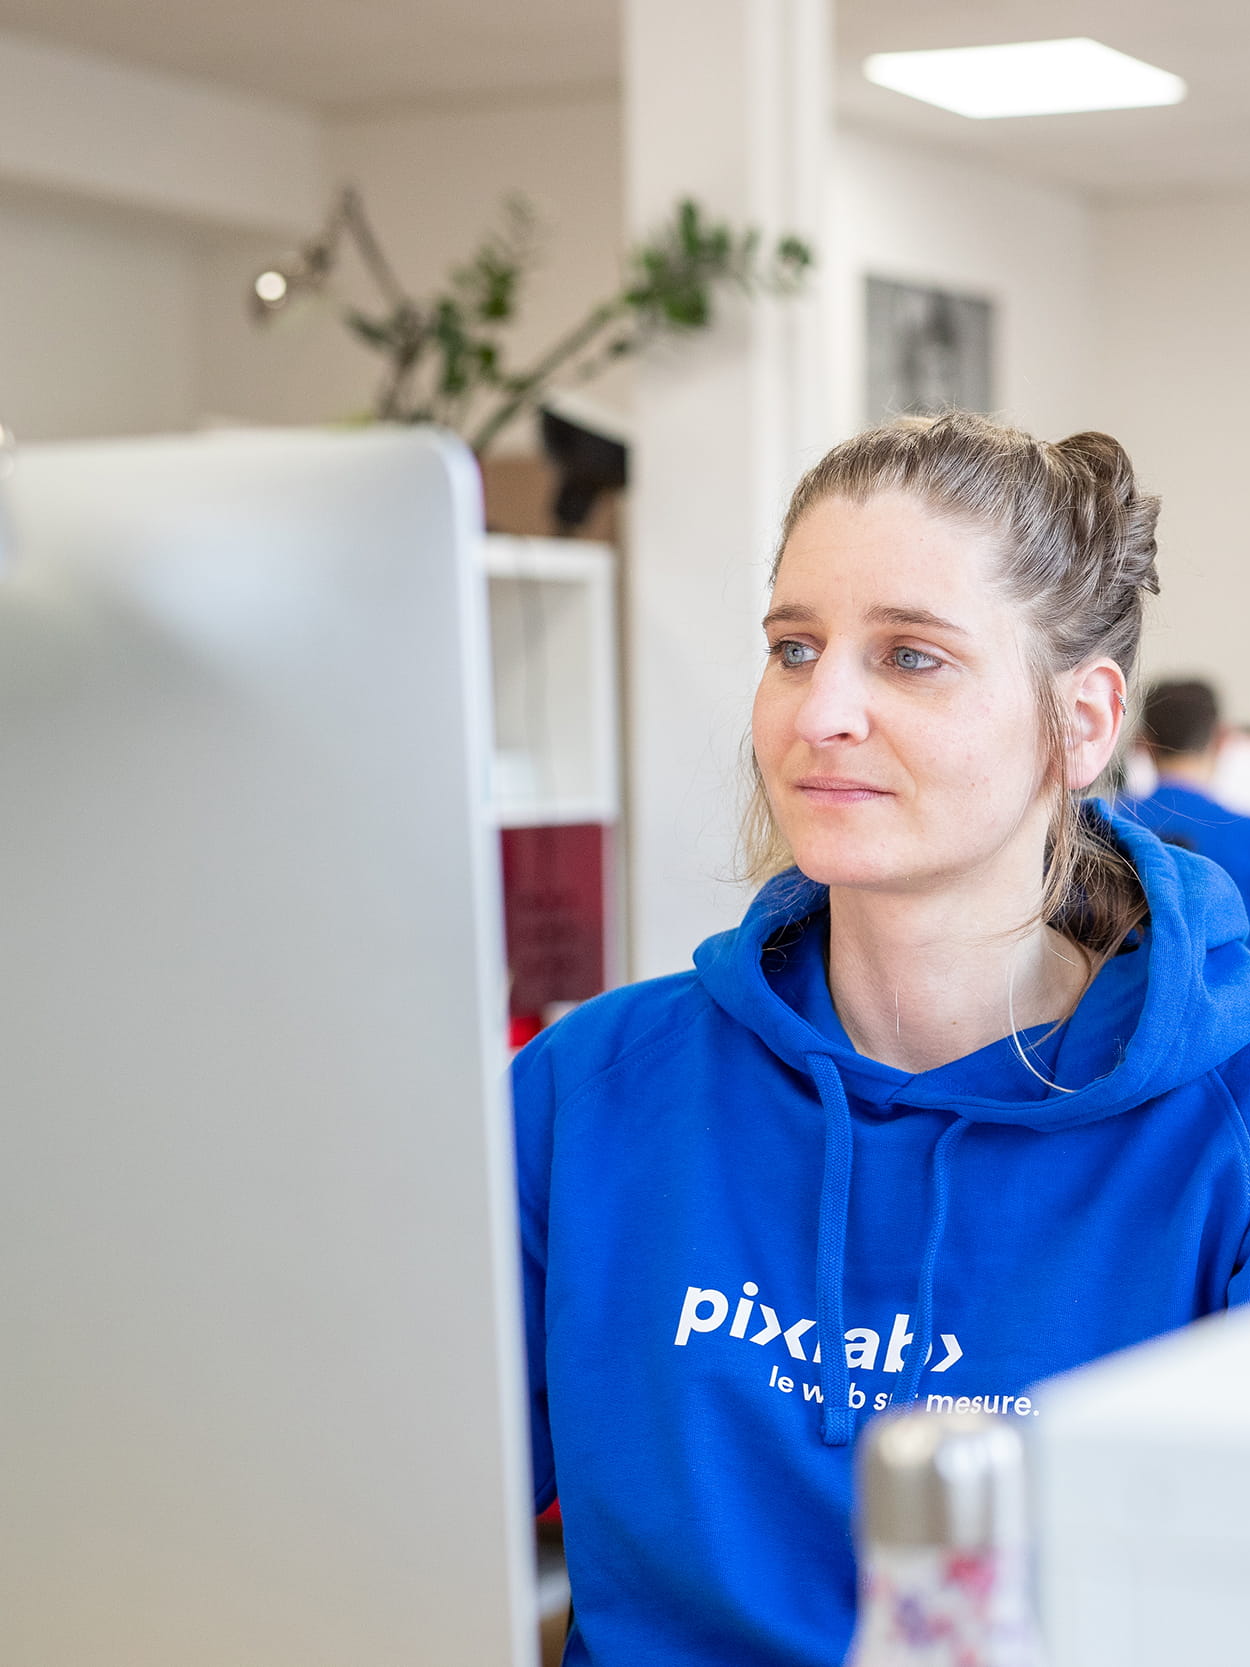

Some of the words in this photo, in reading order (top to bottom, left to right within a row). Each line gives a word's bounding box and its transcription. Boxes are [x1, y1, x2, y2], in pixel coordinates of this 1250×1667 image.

[674, 1281, 935, 1373] pixab
[769, 1365, 795, 1393] le
[802, 1382, 866, 1409] wb
[926, 1394, 1039, 1416] mesure.
